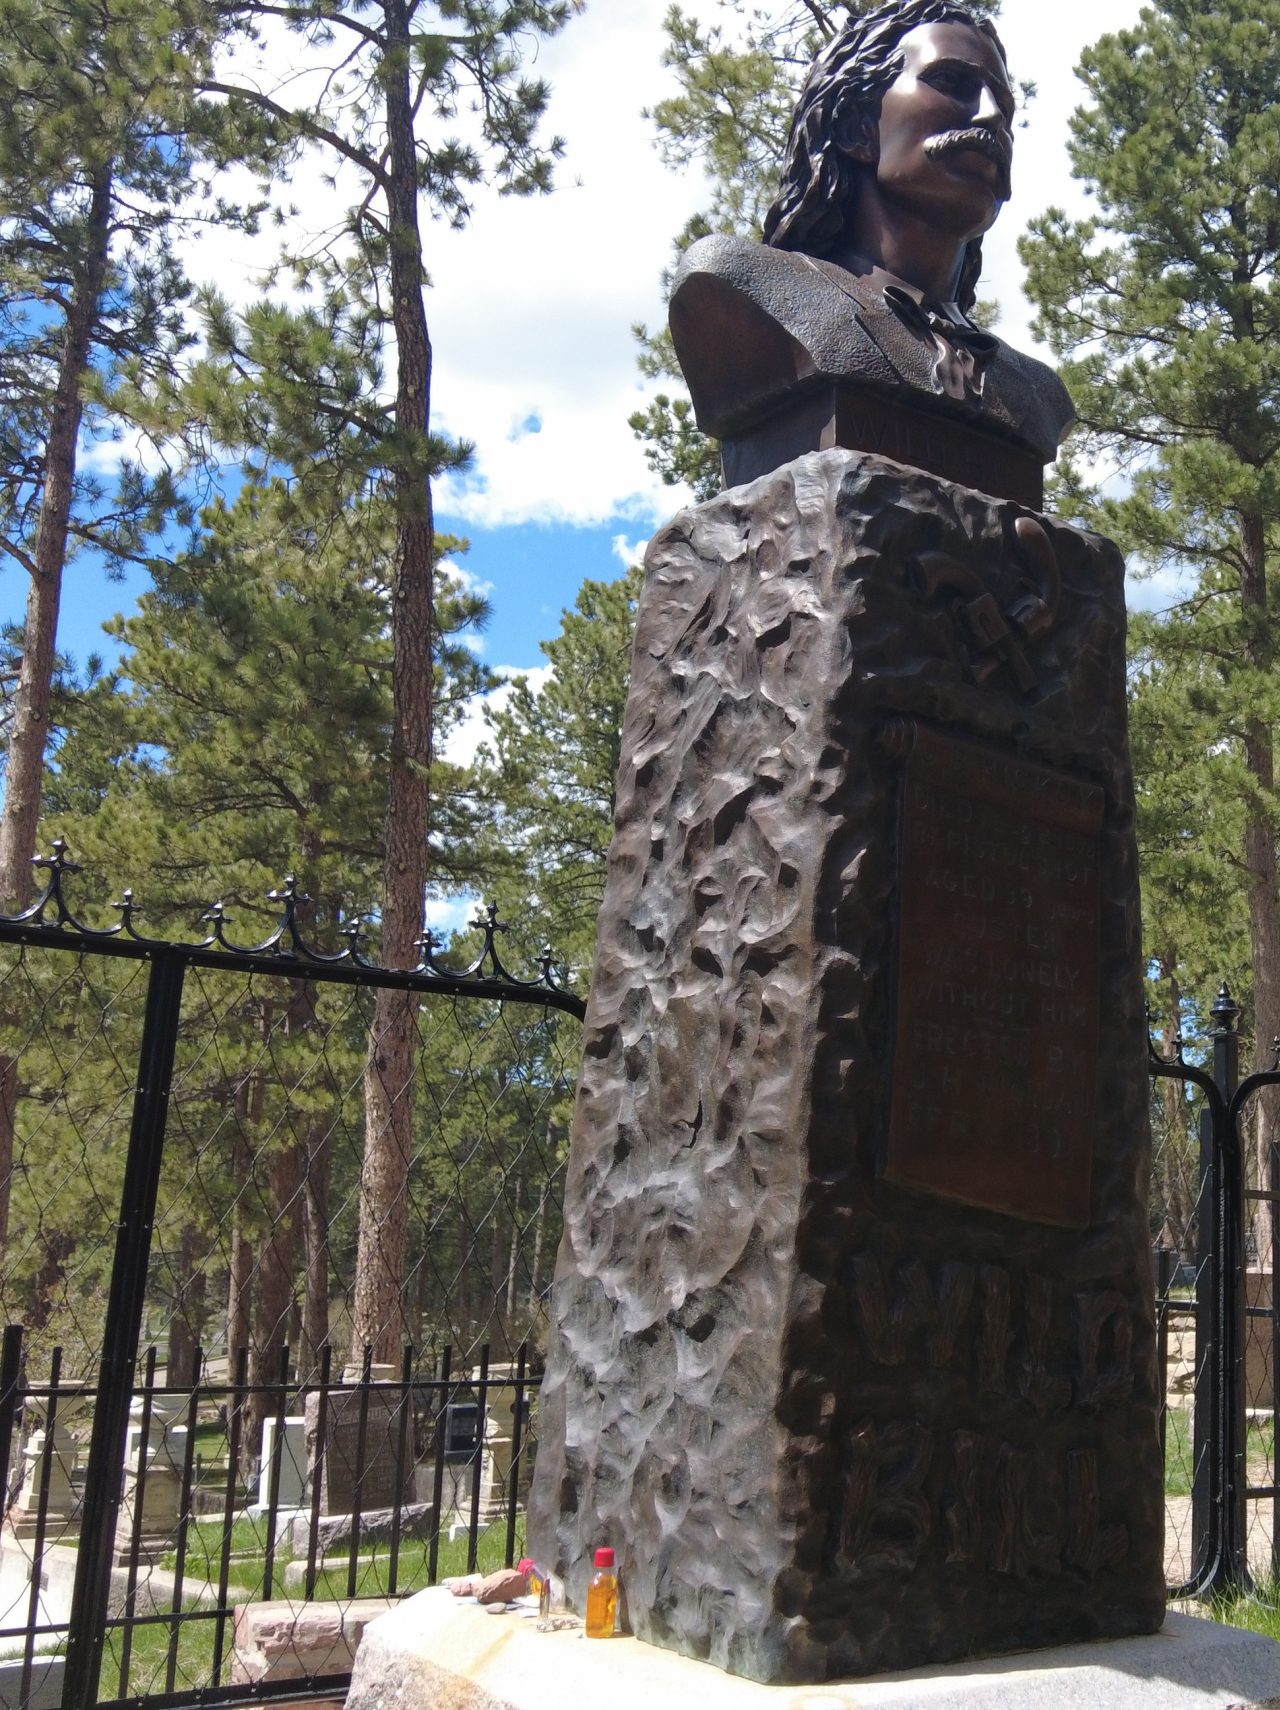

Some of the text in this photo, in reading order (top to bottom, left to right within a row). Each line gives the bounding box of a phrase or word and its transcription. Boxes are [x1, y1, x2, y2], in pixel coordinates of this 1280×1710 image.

[925, 868, 996, 902] AGED
[988, 951, 1081, 991] LONELY
[913, 979, 1087, 1027] WITHOUT HIM
[836, 1417, 1131, 1580] BILL
